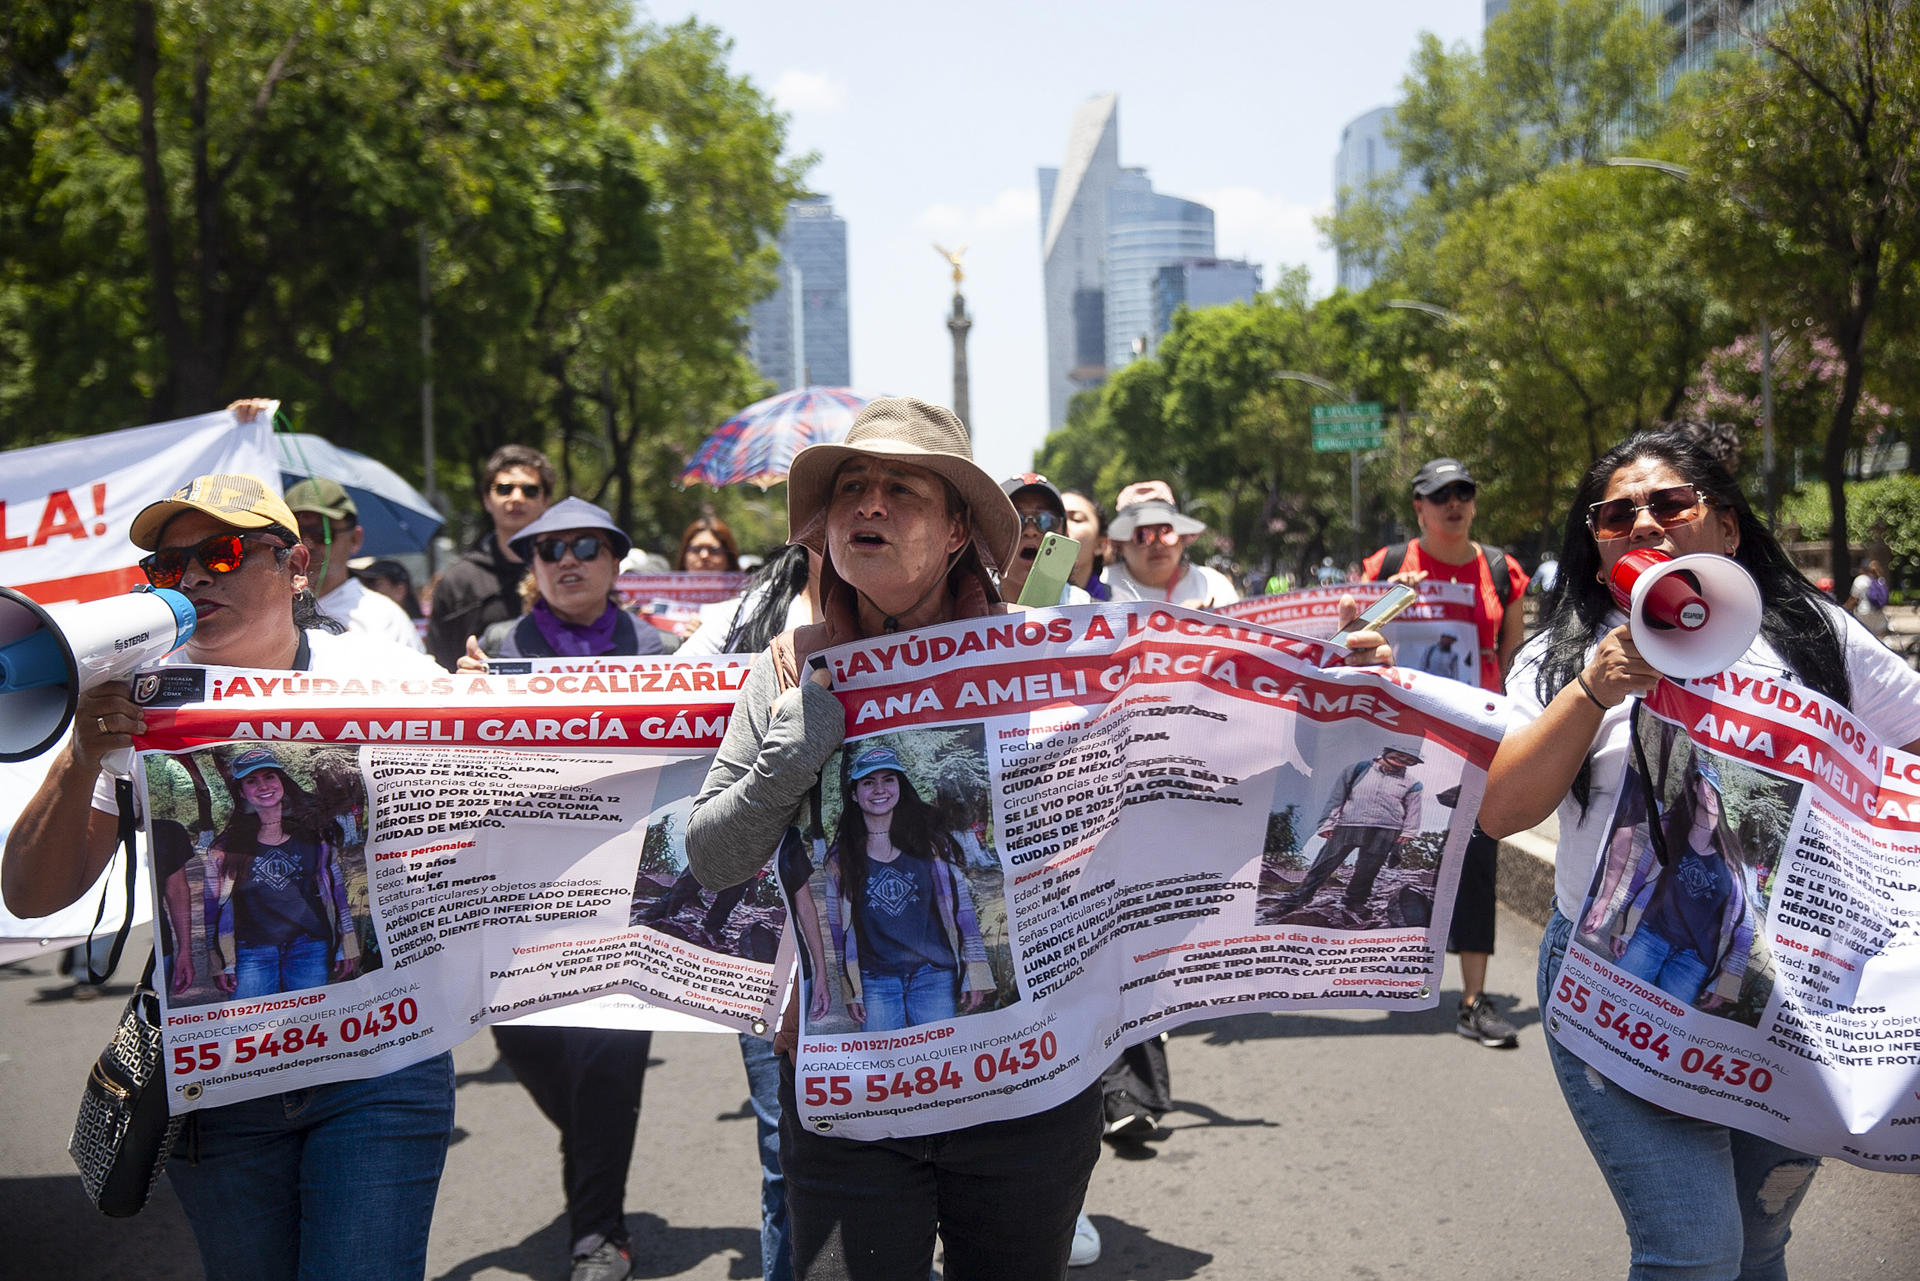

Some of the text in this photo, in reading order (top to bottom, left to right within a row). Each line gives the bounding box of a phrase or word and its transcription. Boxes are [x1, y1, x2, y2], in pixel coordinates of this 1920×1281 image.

[124, 632, 149, 648] STEREN
[835, 617, 1072, 683] ¡AYÚDANOS
[1084, 615, 1114, 641] A
[467, 677, 495, 695] A
[855, 650, 1399, 726] ANA AMELI GARCÍA GÁMEZ
[229, 710, 732, 740] ANA AMELI GARCÍA GÁM
[1694, 713, 1774, 758] ANA
[1784, 744, 1858, 802] AMELI
[1867, 746, 1877, 769] A
[376, 807, 390, 819] DE
[393, 801, 432, 813] JULIO
[435, 800, 454, 808] DE
[458, 798, 490, 807] 2025
[515, 800, 533, 808] LA
[537, 801, 599, 811] COLONIA
[377, 795, 389, 805] SE
[392, 792, 407, 802] LE
[410, 789, 435, 798] VIO
[439, 789, 468, 797] POR
[473, 788, 525, 798] ÚLTIMA
[530, 792, 557, 800] VEZ
[560, 793, 576, 801] EL
[579, 792, 603, 802] DÍA
[376, 808, 623, 832] HÉROES DE 1910, ALCALDÍA TLALPAN,
[375, 840, 476, 862] Datos personales:
[376, 856, 456, 879] Edad: 19 años
[376, 870, 443, 892] Sexo: Mujer
[378, 873, 496, 905] Estatura: 1.61 metros
[1014, 867, 1081, 903] Edad: 19 años
[1787, 874, 1870, 913] SE LE VIO POR
[1015, 884, 1071, 918] Sexo: Mujer
[1017, 879, 1115, 932] Estatura: 1.61 metros
[1784, 887, 1896, 939] DE JULIO DE 2025 EN
[388, 898, 611, 945] LUNAR EN EL LABIO INFERIOR DE LADO
[1778, 914, 1831, 938] CIUDAD
[1834, 933, 1842, 944] DE
[394, 943, 445, 971] ASTILLADO.
[1028, 907, 1219, 988] DERECHO, DIENTE FROTAL SUPERIOR
[1183, 945, 1435, 962] CHAMARRA BLANCA CON FORRO AZUL,
[1776, 934, 1809, 952] Datos
[1174, 965, 1433, 987] Y UN PAR DE BOTAS CAFÉ DE ESCALADA.
[1569, 948, 1685, 1017] Folio: D/01927/2025/CBP
[1774, 951, 1840, 984] Edad: 19 años
[1801, 976, 1829, 993] Mujer
[168, 993, 326, 1026] Folio: D/01927/2025/CBP
[169, 1022, 265, 1044] AGRADECEMOS
[267, 1009, 336, 1029] CUALQUIER
[339, 986, 407, 1016] INFORMACIÓN
[1104, 1038, 1112, 1049] SE
[1113, 1028, 1120, 1040] LE
[1120, 1019, 1137, 1032] VIO
[1139, 1010, 1162, 1025] POR
[1165, 999, 1208, 1018] ÚLTIMA
[1210, 995, 1235, 1007] VEZ
[1238, 993, 1255, 1002] EN
[1258, 990, 1289, 1000] PICO
[1293, 992, 1318, 1000] DEL
[1321, 987, 1372, 999] ÁGUILA,
[1564, 964, 1628, 1007] AGRADECEMOS
[1629, 1002, 1686, 1039] CUALQUIER
[1688, 1033, 1770, 1066] INFORMACIÓN
[173, 997, 418, 1075] 55 5484 0430
[802, 1027, 955, 1054] Folio: D/01927/2025/CBP
[802, 1060, 895, 1072] AGRADECEMOS
[898, 1045, 968, 1067] CUALQUIER
[970, 1020, 1048, 1052] INFORMACIÓN
[1556, 975, 1772, 1093] 55 5484 0430
[804, 1030, 1058, 1106] 55 5484 0430
[1552, 1005, 1790, 1123] comisionbusquedadepersonas@cdmx.gob.mx
[808, 1054, 1080, 1122] comisionbusquedadepersonas@cdmx.gob.mx
